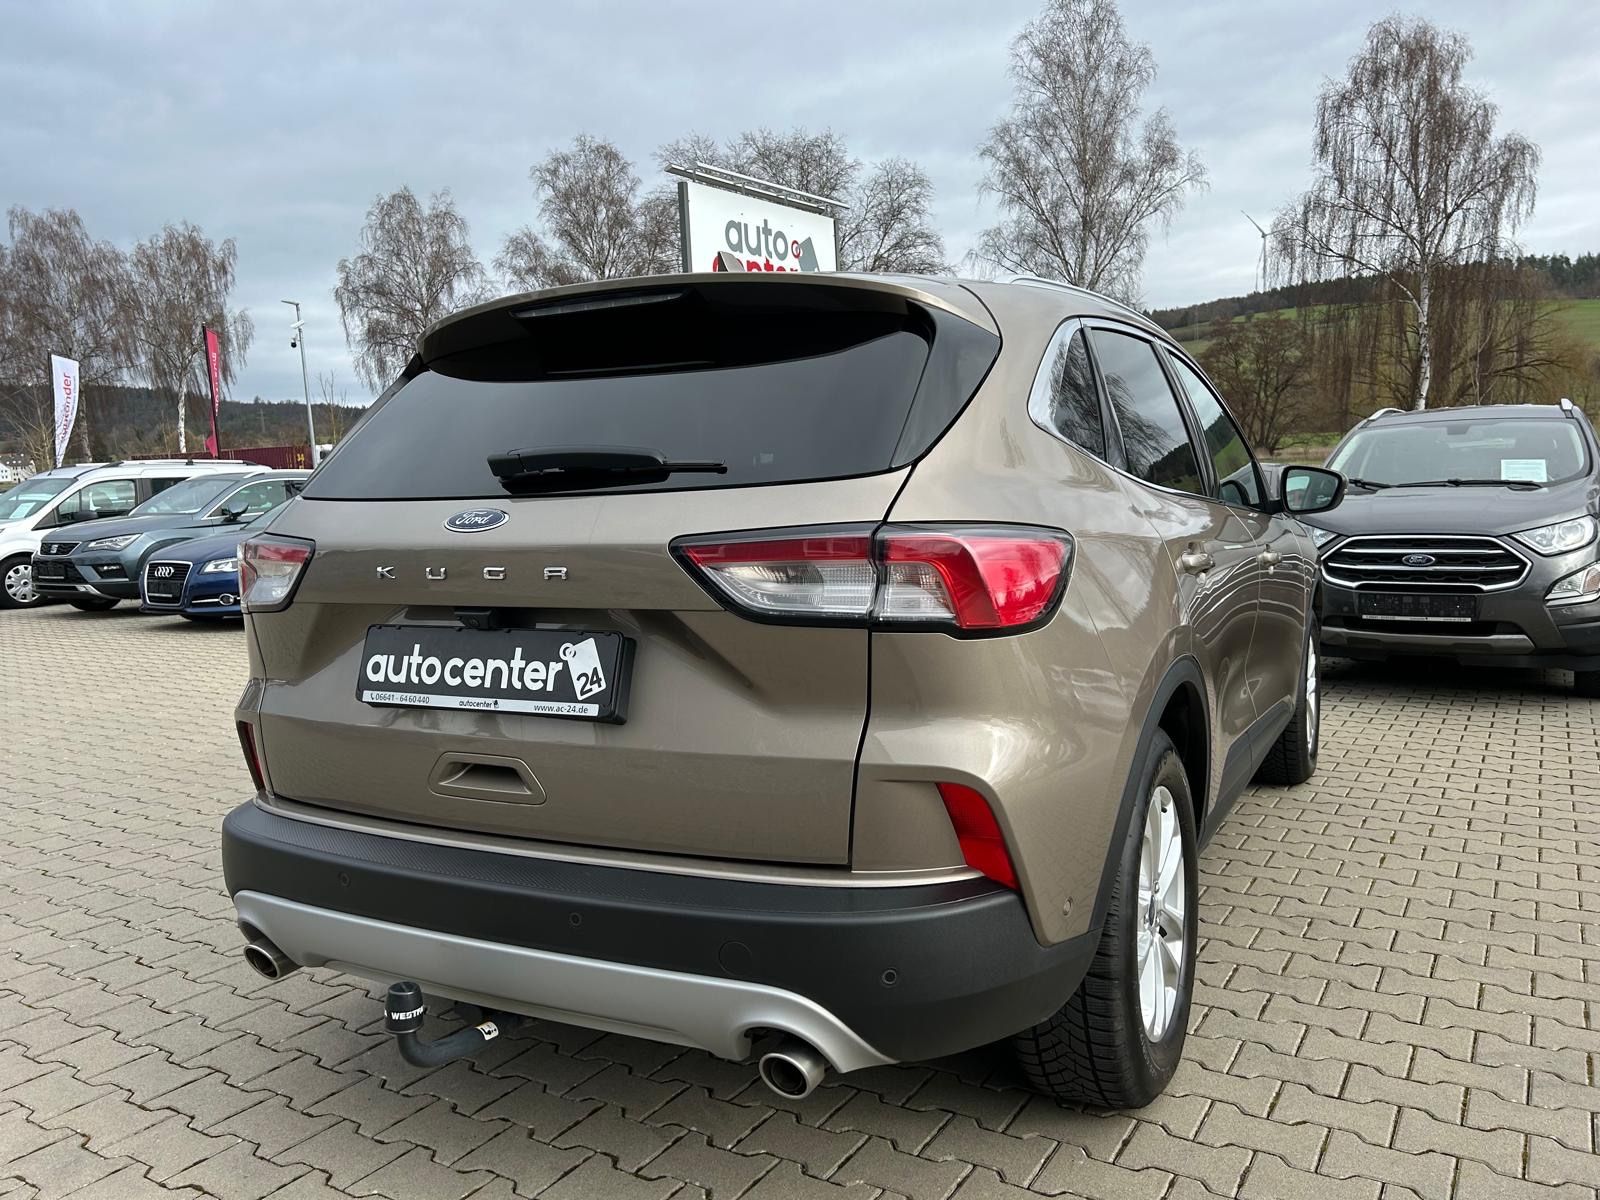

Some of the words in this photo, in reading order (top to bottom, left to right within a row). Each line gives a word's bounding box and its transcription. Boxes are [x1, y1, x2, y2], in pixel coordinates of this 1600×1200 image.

[725, 219, 789, 261] auto
[455, 511, 491, 525] Ford
[376, 566, 568, 580] KUGA
[576, 666, 603, 696] 24
[375, 692, 395, 702] 06641
[458, 699, 493, 709] autocenter
[534, 703, 589, 715] www.ac-24.de
